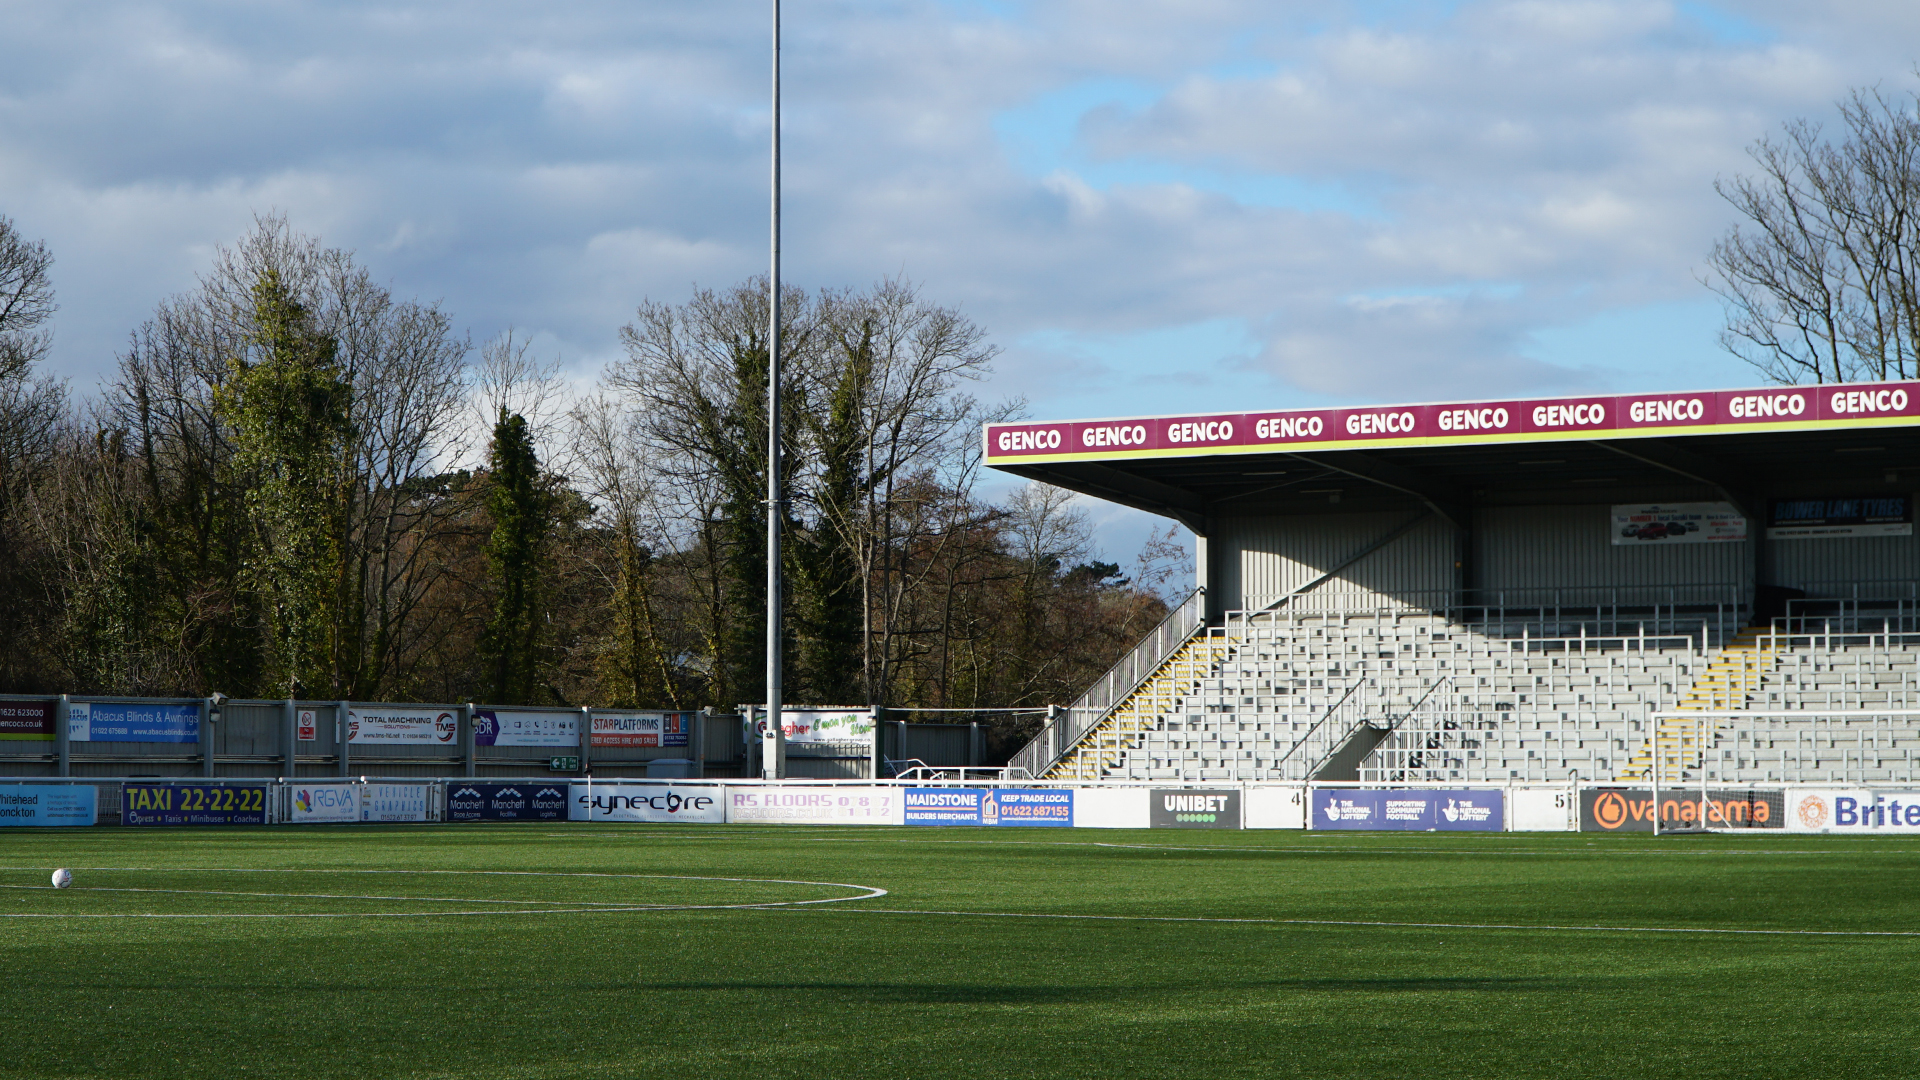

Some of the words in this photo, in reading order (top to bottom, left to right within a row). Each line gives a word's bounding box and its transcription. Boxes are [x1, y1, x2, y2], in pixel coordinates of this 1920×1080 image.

[999, 430, 1061, 451] GENCO
[1083, 426, 1146, 447] GENCO
[1167, 421, 1233, 443] GENCO
[1256, 417, 1323, 439] GENCO
[1346, 412, 1414, 435] GENCO
[1439, 408, 1508, 431] GENCO
[1533, 404, 1604, 427] GENCO
[1630, 399, 1703, 423] GENCO
[1730, 394, 1805, 418] GENCO
[1831, 390, 1907, 414] GENCO
[1775, 501, 1825, 520] BOWER
[1826, 500, 1861, 518] LANE
[1862, 498, 1904, 517] TYRES
[0, 708, 16, 717] 1622
[17, 709, 44, 717] 623000
[92, 711, 124, 722] Abacus
[126, 711, 154, 722] Blinds
[156, 712, 163, 722] &
[164, 712, 199, 726] Awnings
[363, 716, 387, 724] TOTAL
[388, 717, 432, 725] MACHINING
[0, 719, 43, 730] encocs.co.uk
[435, 723, 456, 732] TMS
[594, 718, 659, 731] STARPLATFORMS
[132, 728, 198, 736] www.abacusblinds.co.uk
[603, 736, 620, 745] ACCESS
[622, 737, 632, 745] HIRE
[633, 737, 643, 745] AND
[643, 736, 657, 744] SALES
[379, 786, 420, 798] VEHICLE
[127, 788, 171, 811] TAXI
[313, 789, 354, 807] RGVA
[578, 791, 714, 815] synecore
[734, 794, 758, 807] RS
[764, 794, 833, 807] FLOORS
[906, 794, 978, 807] MAIDSTONE
[1001, 794, 1019, 803] KEEP
[1019, 795, 1044, 803] TRADE
[1045, 795, 1069, 803] LOCAL
[1164, 795, 1228, 812] UNIBET
[1291, 792, 1301, 806] 4
[1554, 794, 1565, 808] 5
[374, 800, 424, 812] GRAPHICS
[450, 799, 484, 810] Manchett
[491, 799, 525, 810] Manchett
[532, 799, 565, 810] Manchett
[1341, 800, 1353, 808] THE
[0, 807, 35, 818] onckton
[906, 812, 937, 821] BUILDERS
[937, 813, 978, 821] MERCHANTS
[1001, 806, 1031, 817] 01622
[1032, 806, 1069, 817] 687155
[1628, 800, 1771, 822] vanarama
[164, 815, 182, 823] Taxis
[191, 814, 225, 824] Minibuses
[233, 815, 260, 824] Coaches
[1341, 813, 1368, 821] LOTTERY
[1459, 814, 1489, 822] LOTTERY
